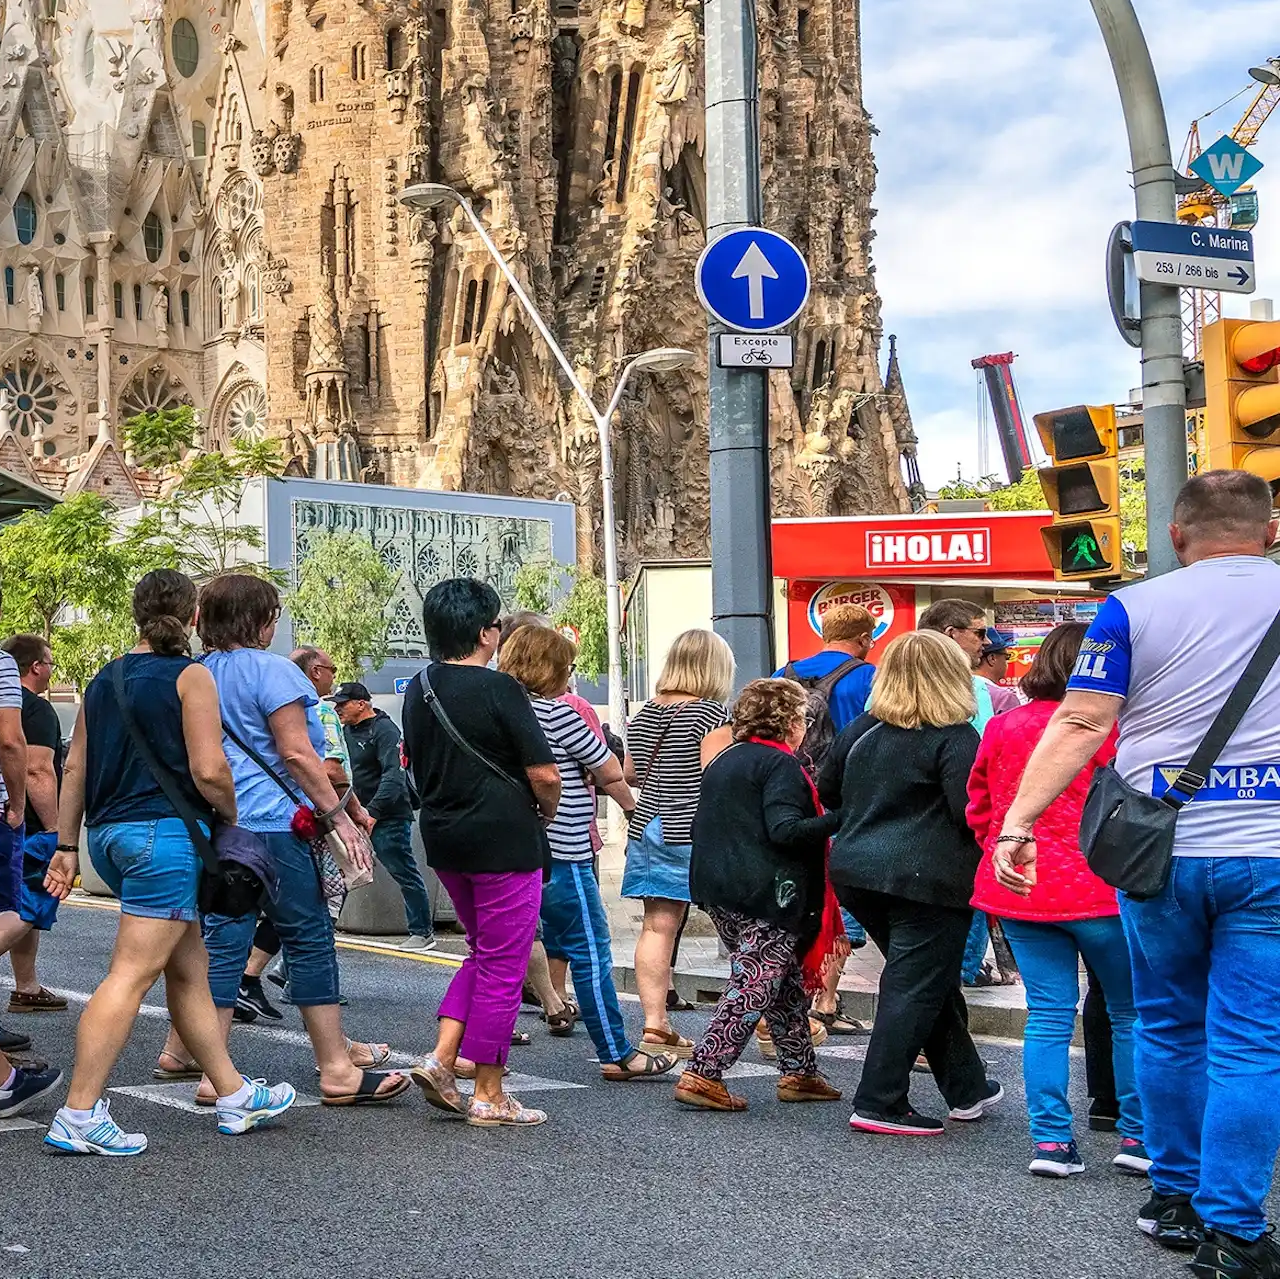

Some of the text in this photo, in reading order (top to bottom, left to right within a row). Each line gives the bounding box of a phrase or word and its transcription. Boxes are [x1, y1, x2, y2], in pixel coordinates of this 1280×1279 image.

[1207, 153, 1245, 180] W
[1191, 231, 1249, 252] C. Marina
[1156, 262, 1174, 274] 253
[1185, 264, 1202, 277] 266
[1205, 266, 1219, 279] bis
[734, 337, 778, 347] Excepte
[871, 534, 985, 563] ¡HOLA!
[1201, 766, 1280, 788] MBA
[1237, 789, 1256, 799] 0.0
